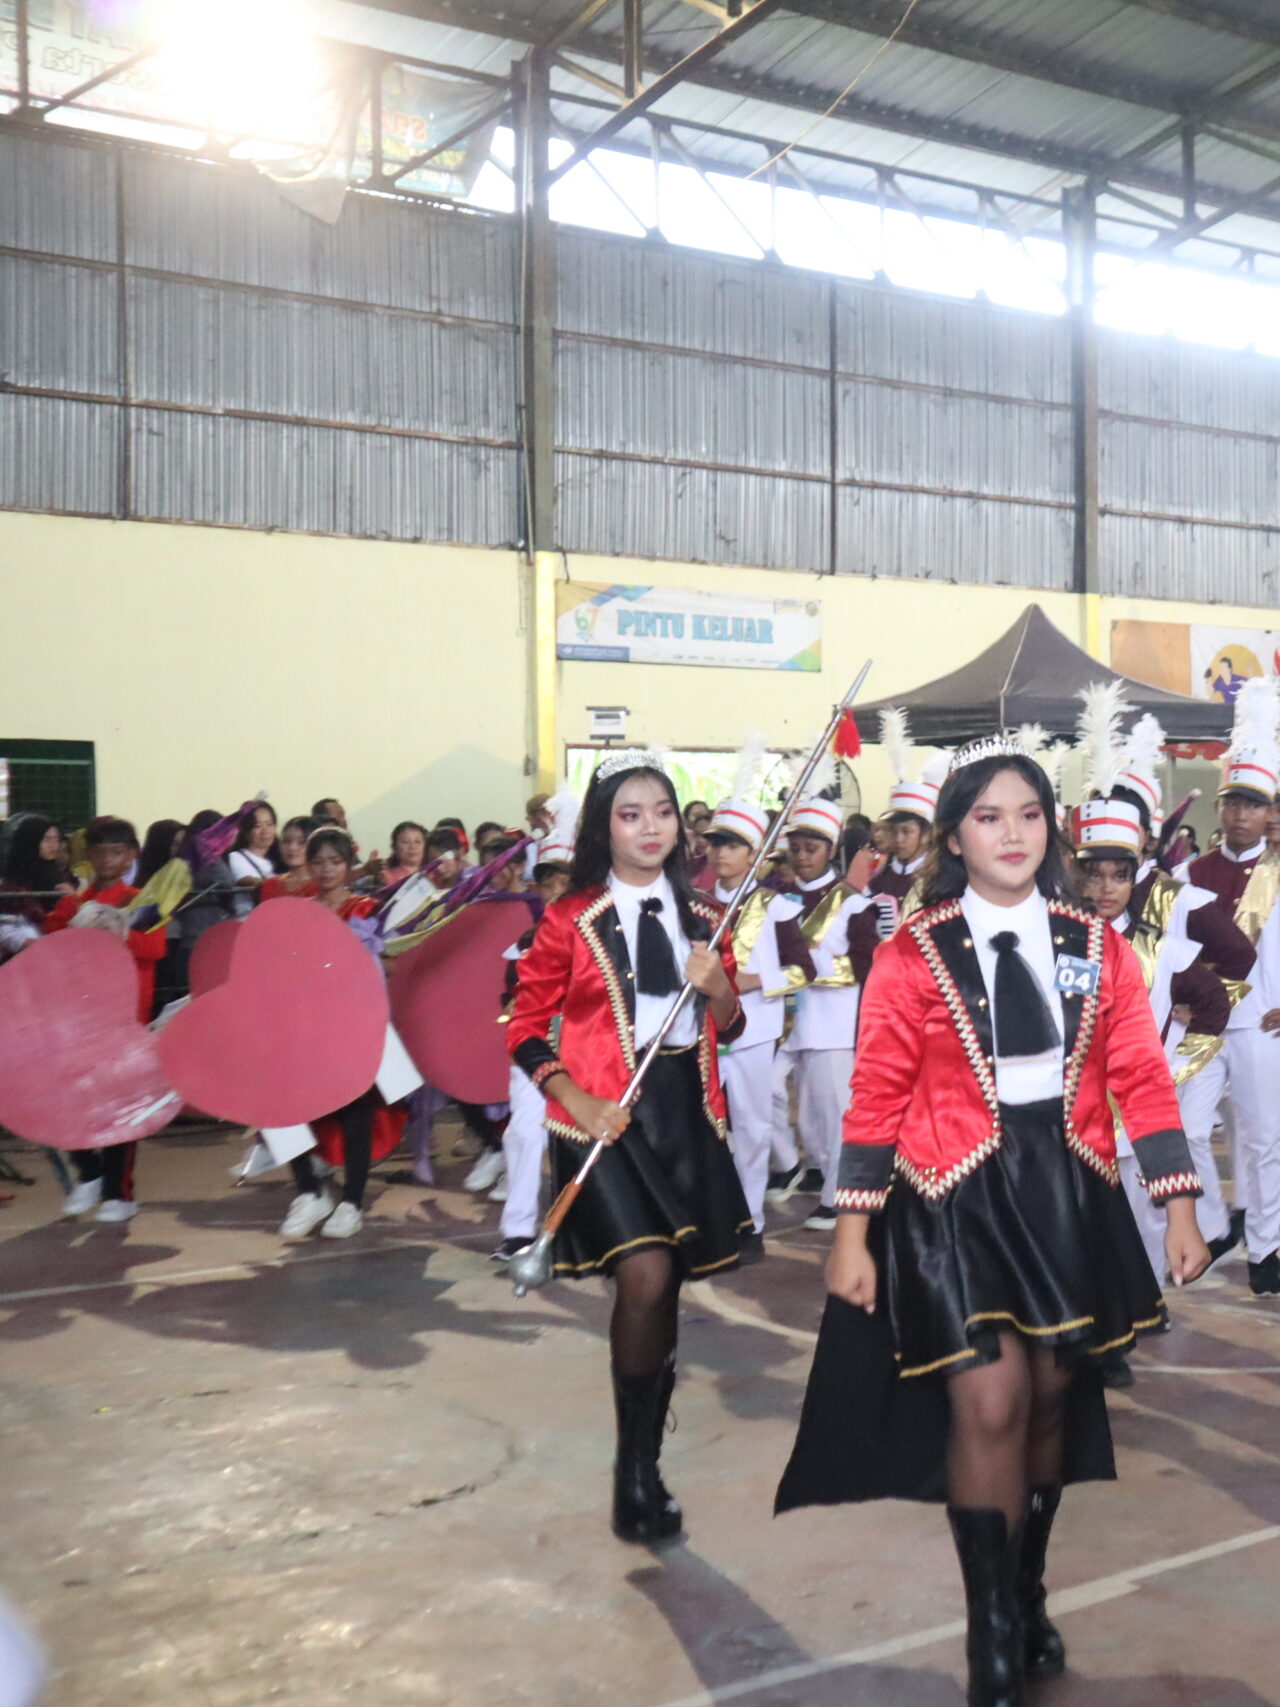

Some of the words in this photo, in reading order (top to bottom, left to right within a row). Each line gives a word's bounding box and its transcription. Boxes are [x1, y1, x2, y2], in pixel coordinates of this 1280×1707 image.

[616, 609, 685, 639] PINTU
[692, 614, 774, 644] KELUAR
[1058, 967, 1091, 991] 04
